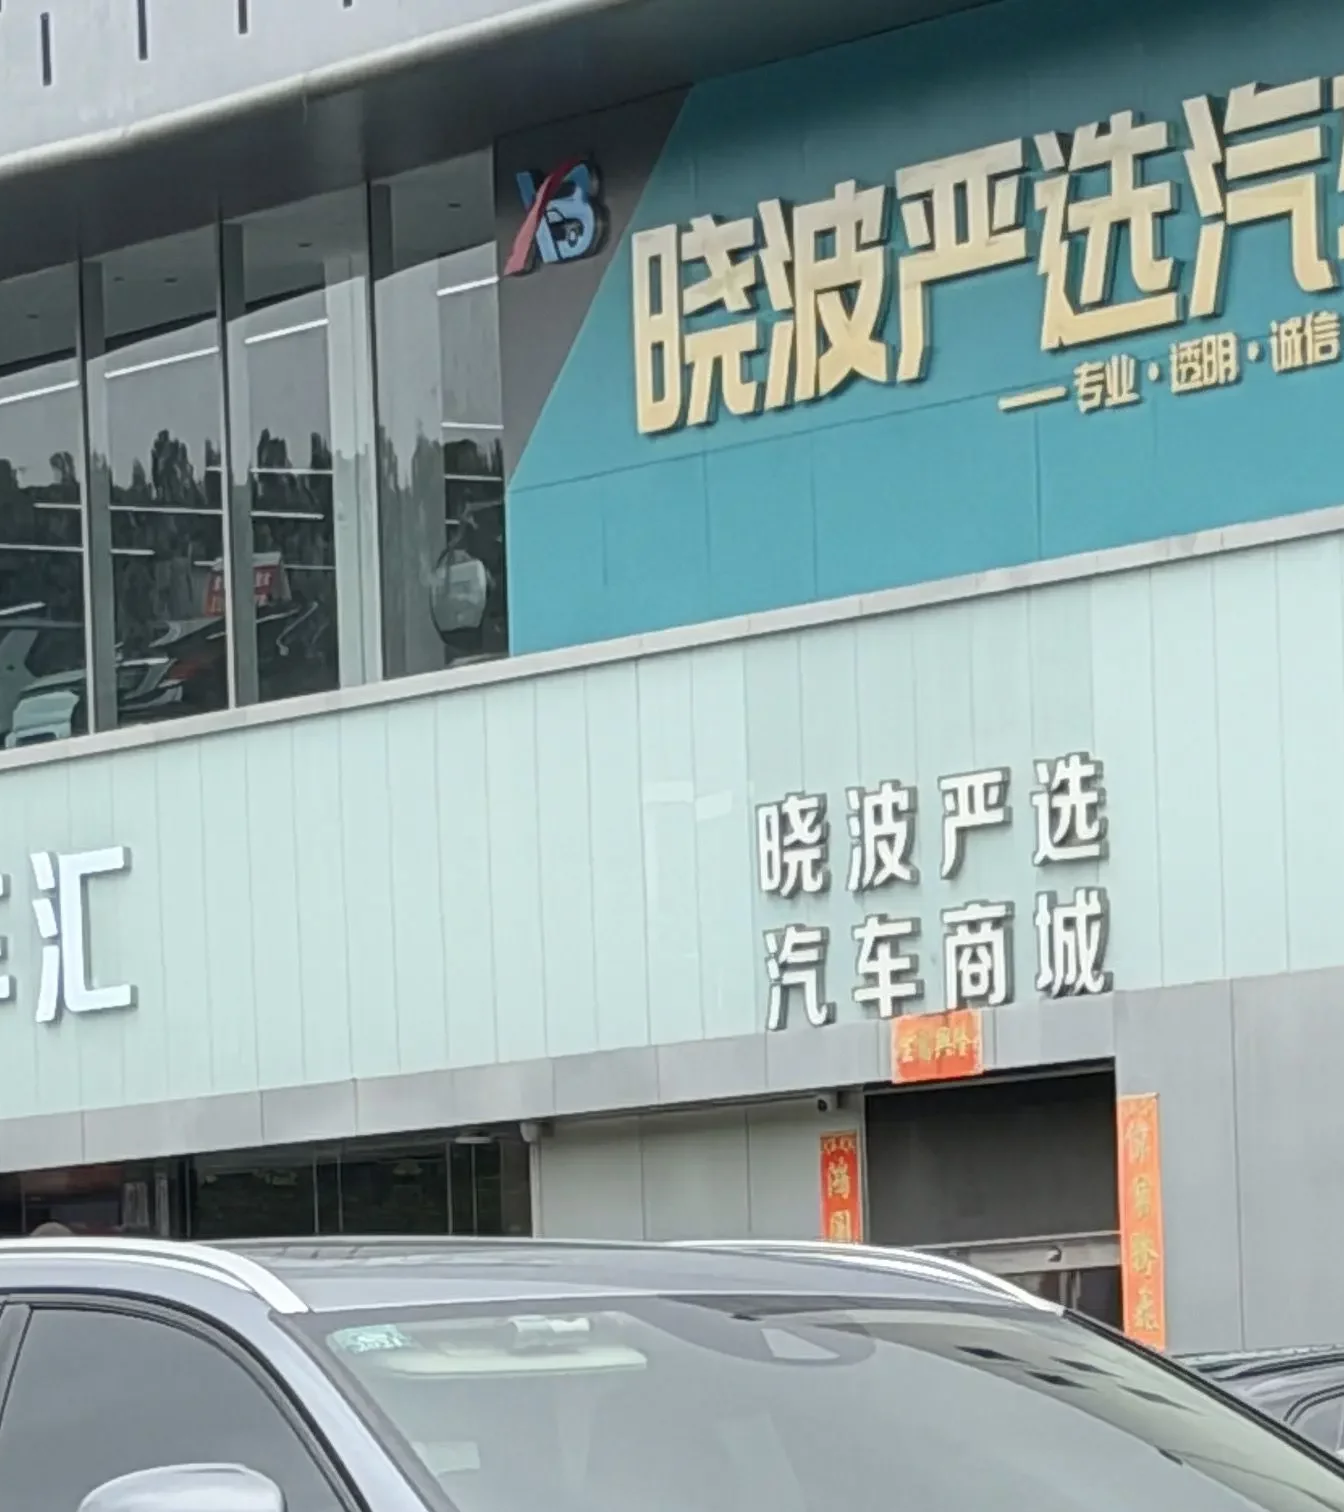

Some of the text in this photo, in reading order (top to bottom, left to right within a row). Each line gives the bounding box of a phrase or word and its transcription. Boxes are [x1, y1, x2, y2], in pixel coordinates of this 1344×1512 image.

[756, 751, 1110, 899] 晓波严选
[764, 886, 1113, 1031] 汽车商城
